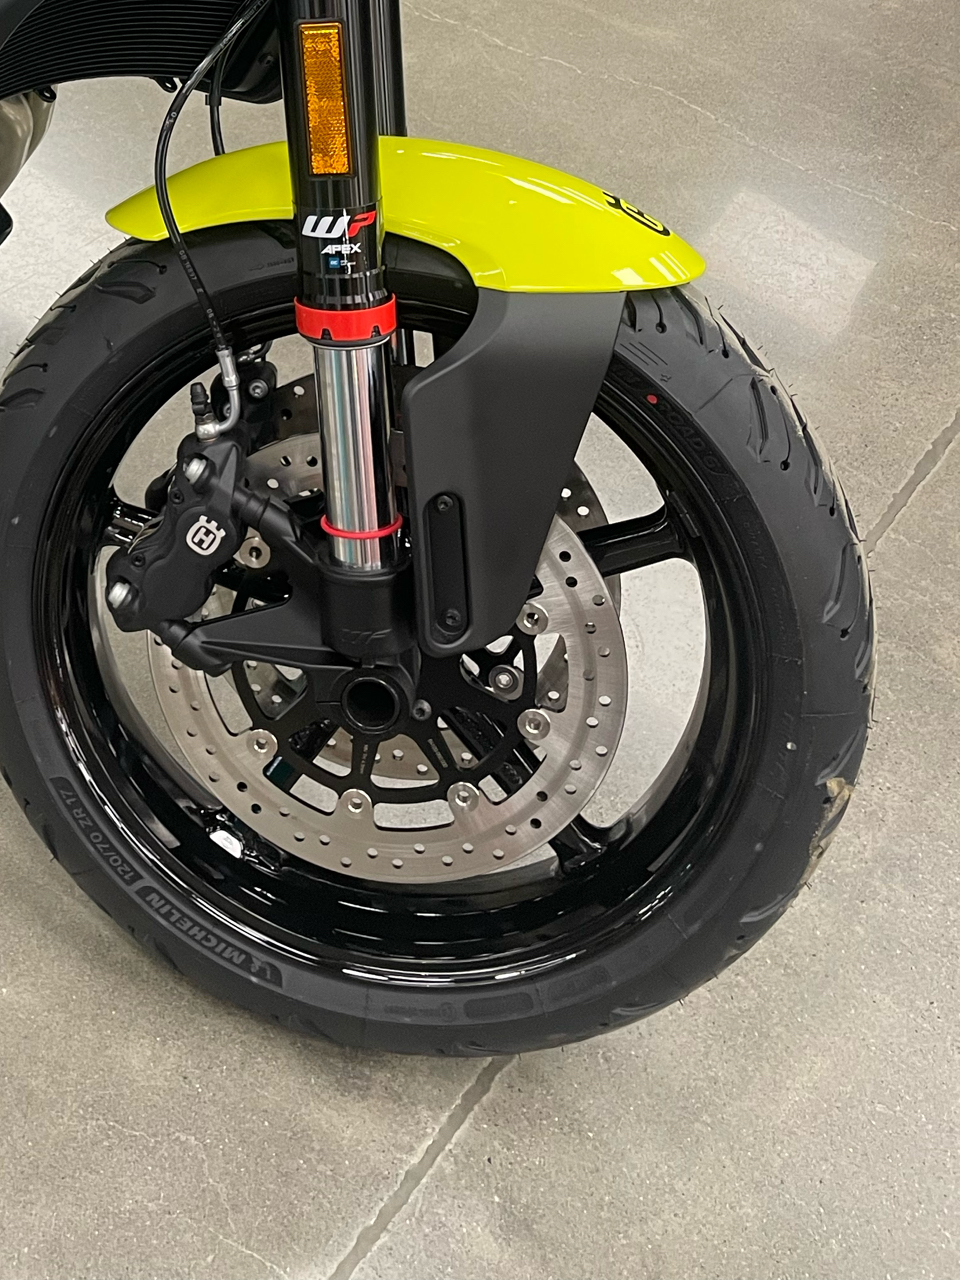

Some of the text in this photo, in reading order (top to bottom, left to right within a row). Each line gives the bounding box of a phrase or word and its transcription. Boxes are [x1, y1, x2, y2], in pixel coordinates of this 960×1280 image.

[301, 210, 377, 239] WP
[321, 242, 362, 254] APEX
[59, 788, 246, 966] MICHELIN 120/70 ZR 17
